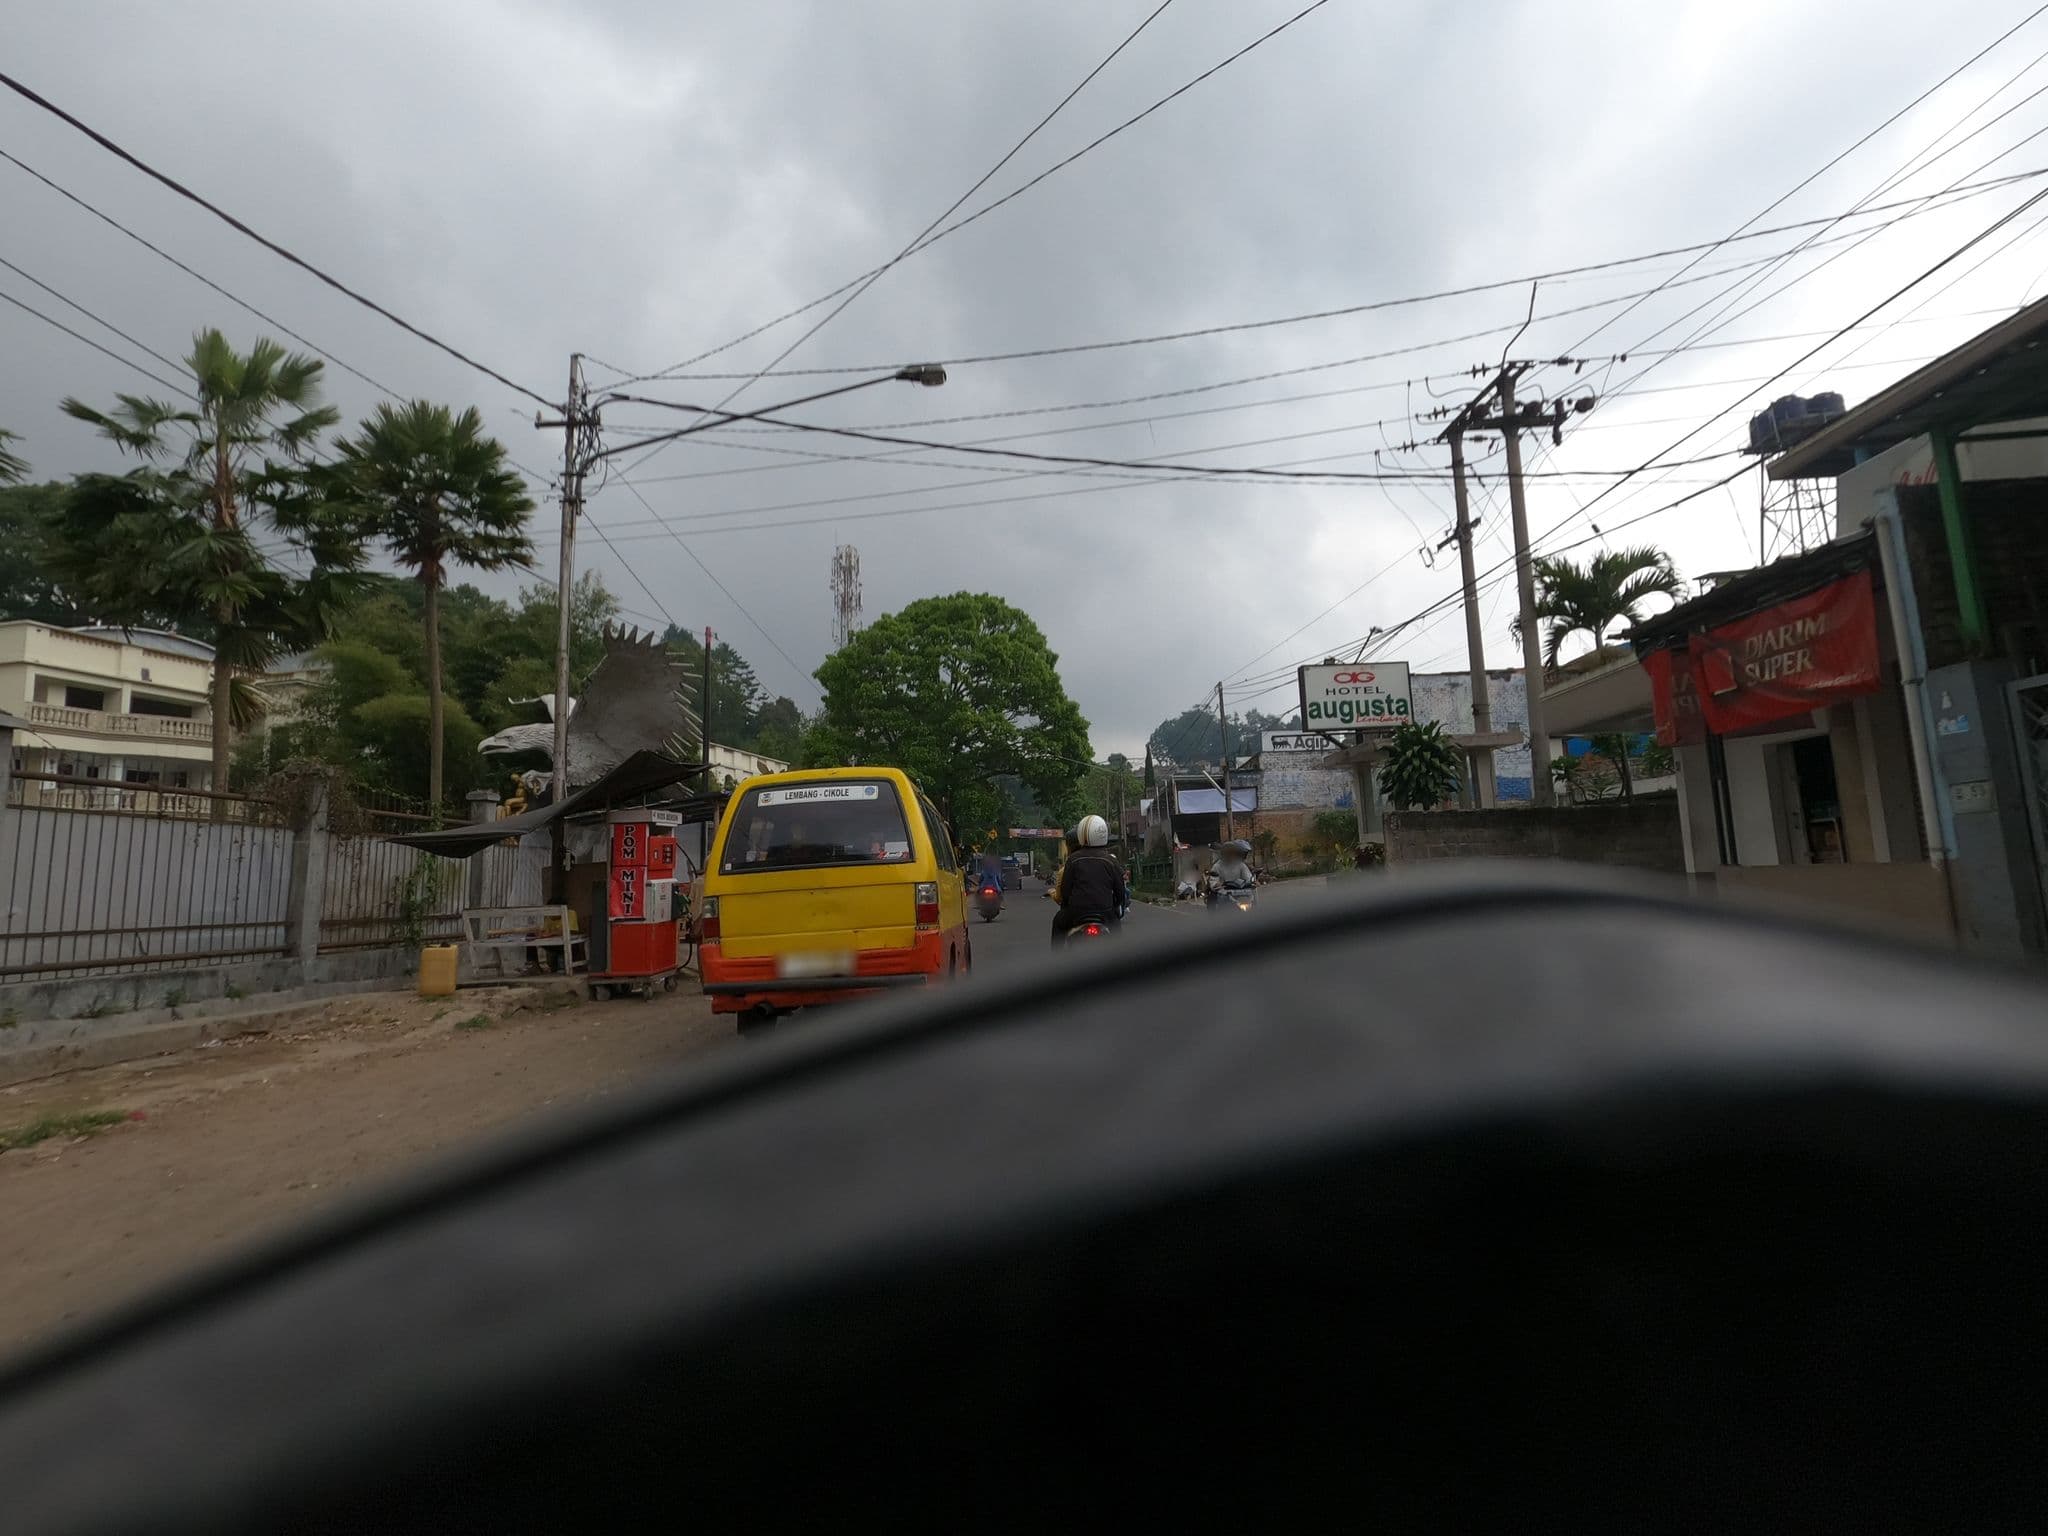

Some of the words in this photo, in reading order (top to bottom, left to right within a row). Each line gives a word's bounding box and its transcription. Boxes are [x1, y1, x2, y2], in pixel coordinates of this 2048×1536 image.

[1745, 648, 1815, 684] SUPER
[1326, 686, 1386, 695] HOTEL
[1308, 694, 1409, 724] augusta
[1294, 736, 1330, 751] Agip
[785, 790, 818, 800] LEMBANG
[824, 788, 850, 798] CIKOLE
[622, 825, 635, 859] POM
[622, 870, 635, 914] MINI
